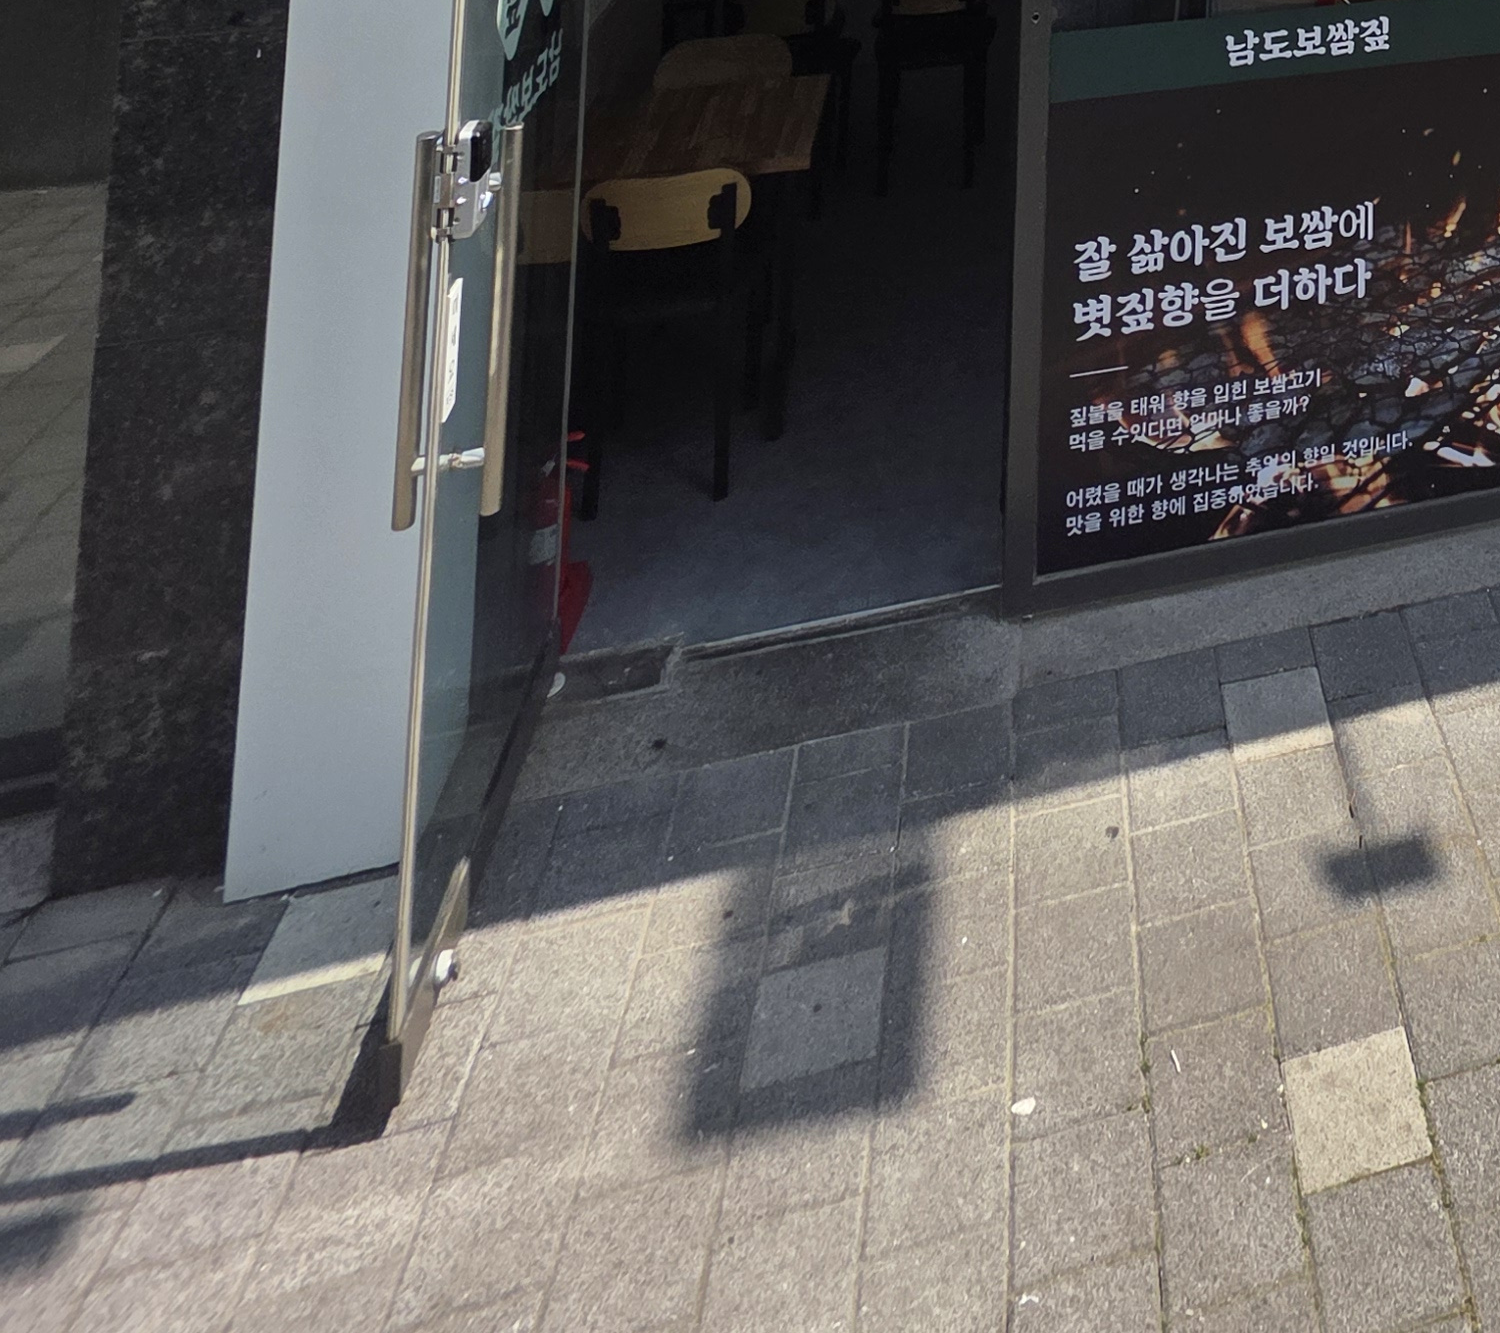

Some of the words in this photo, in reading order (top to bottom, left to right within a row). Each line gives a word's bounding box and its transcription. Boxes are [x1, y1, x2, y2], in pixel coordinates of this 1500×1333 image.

[1225, 16, 1391, 67] 남도보쌈짚
[1073, 235, 1117, 283] 잘
[1127, 217, 1247, 275] 삶아진
[1259, 201, 1375, 254] 보쌈에
[1072, 278, 1241, 342] 볏짚향을
[1253, 258, 1372, 312] 더하다
[1069, 429, 1106, 452] 먹을
[1189, 407, 1242, 434] 얼마나
[1247, 395, 1311, 422] 좋을까?
[1070, 401, 1124, 428] 짚불을
[1131, 393, 1166, 416] 태워
[1172, 388, 1207, 411] 향을
[1213, 380, 1247, 404] 입힌
[1253, 369, 1322, 396] 보쌈고기
[1066, 483, 1121, 510] 어렸을
[1127, 473, 1163, 498] 때가
[1169, 463, 1240, 492] 생각나는
[1245, 450, 1297, 478] 추억의
[1303, 444, 1336, 469] 향일
[1342, 430, 1413, 463] 것입니다.
[1066, 512, 1102, 537] 맛을
[1108, 506, 1144, 529] 위한
[1151, 495, 1187, 522] 향에
[1193, 473, 1319, 514] 집중하였습니다.
